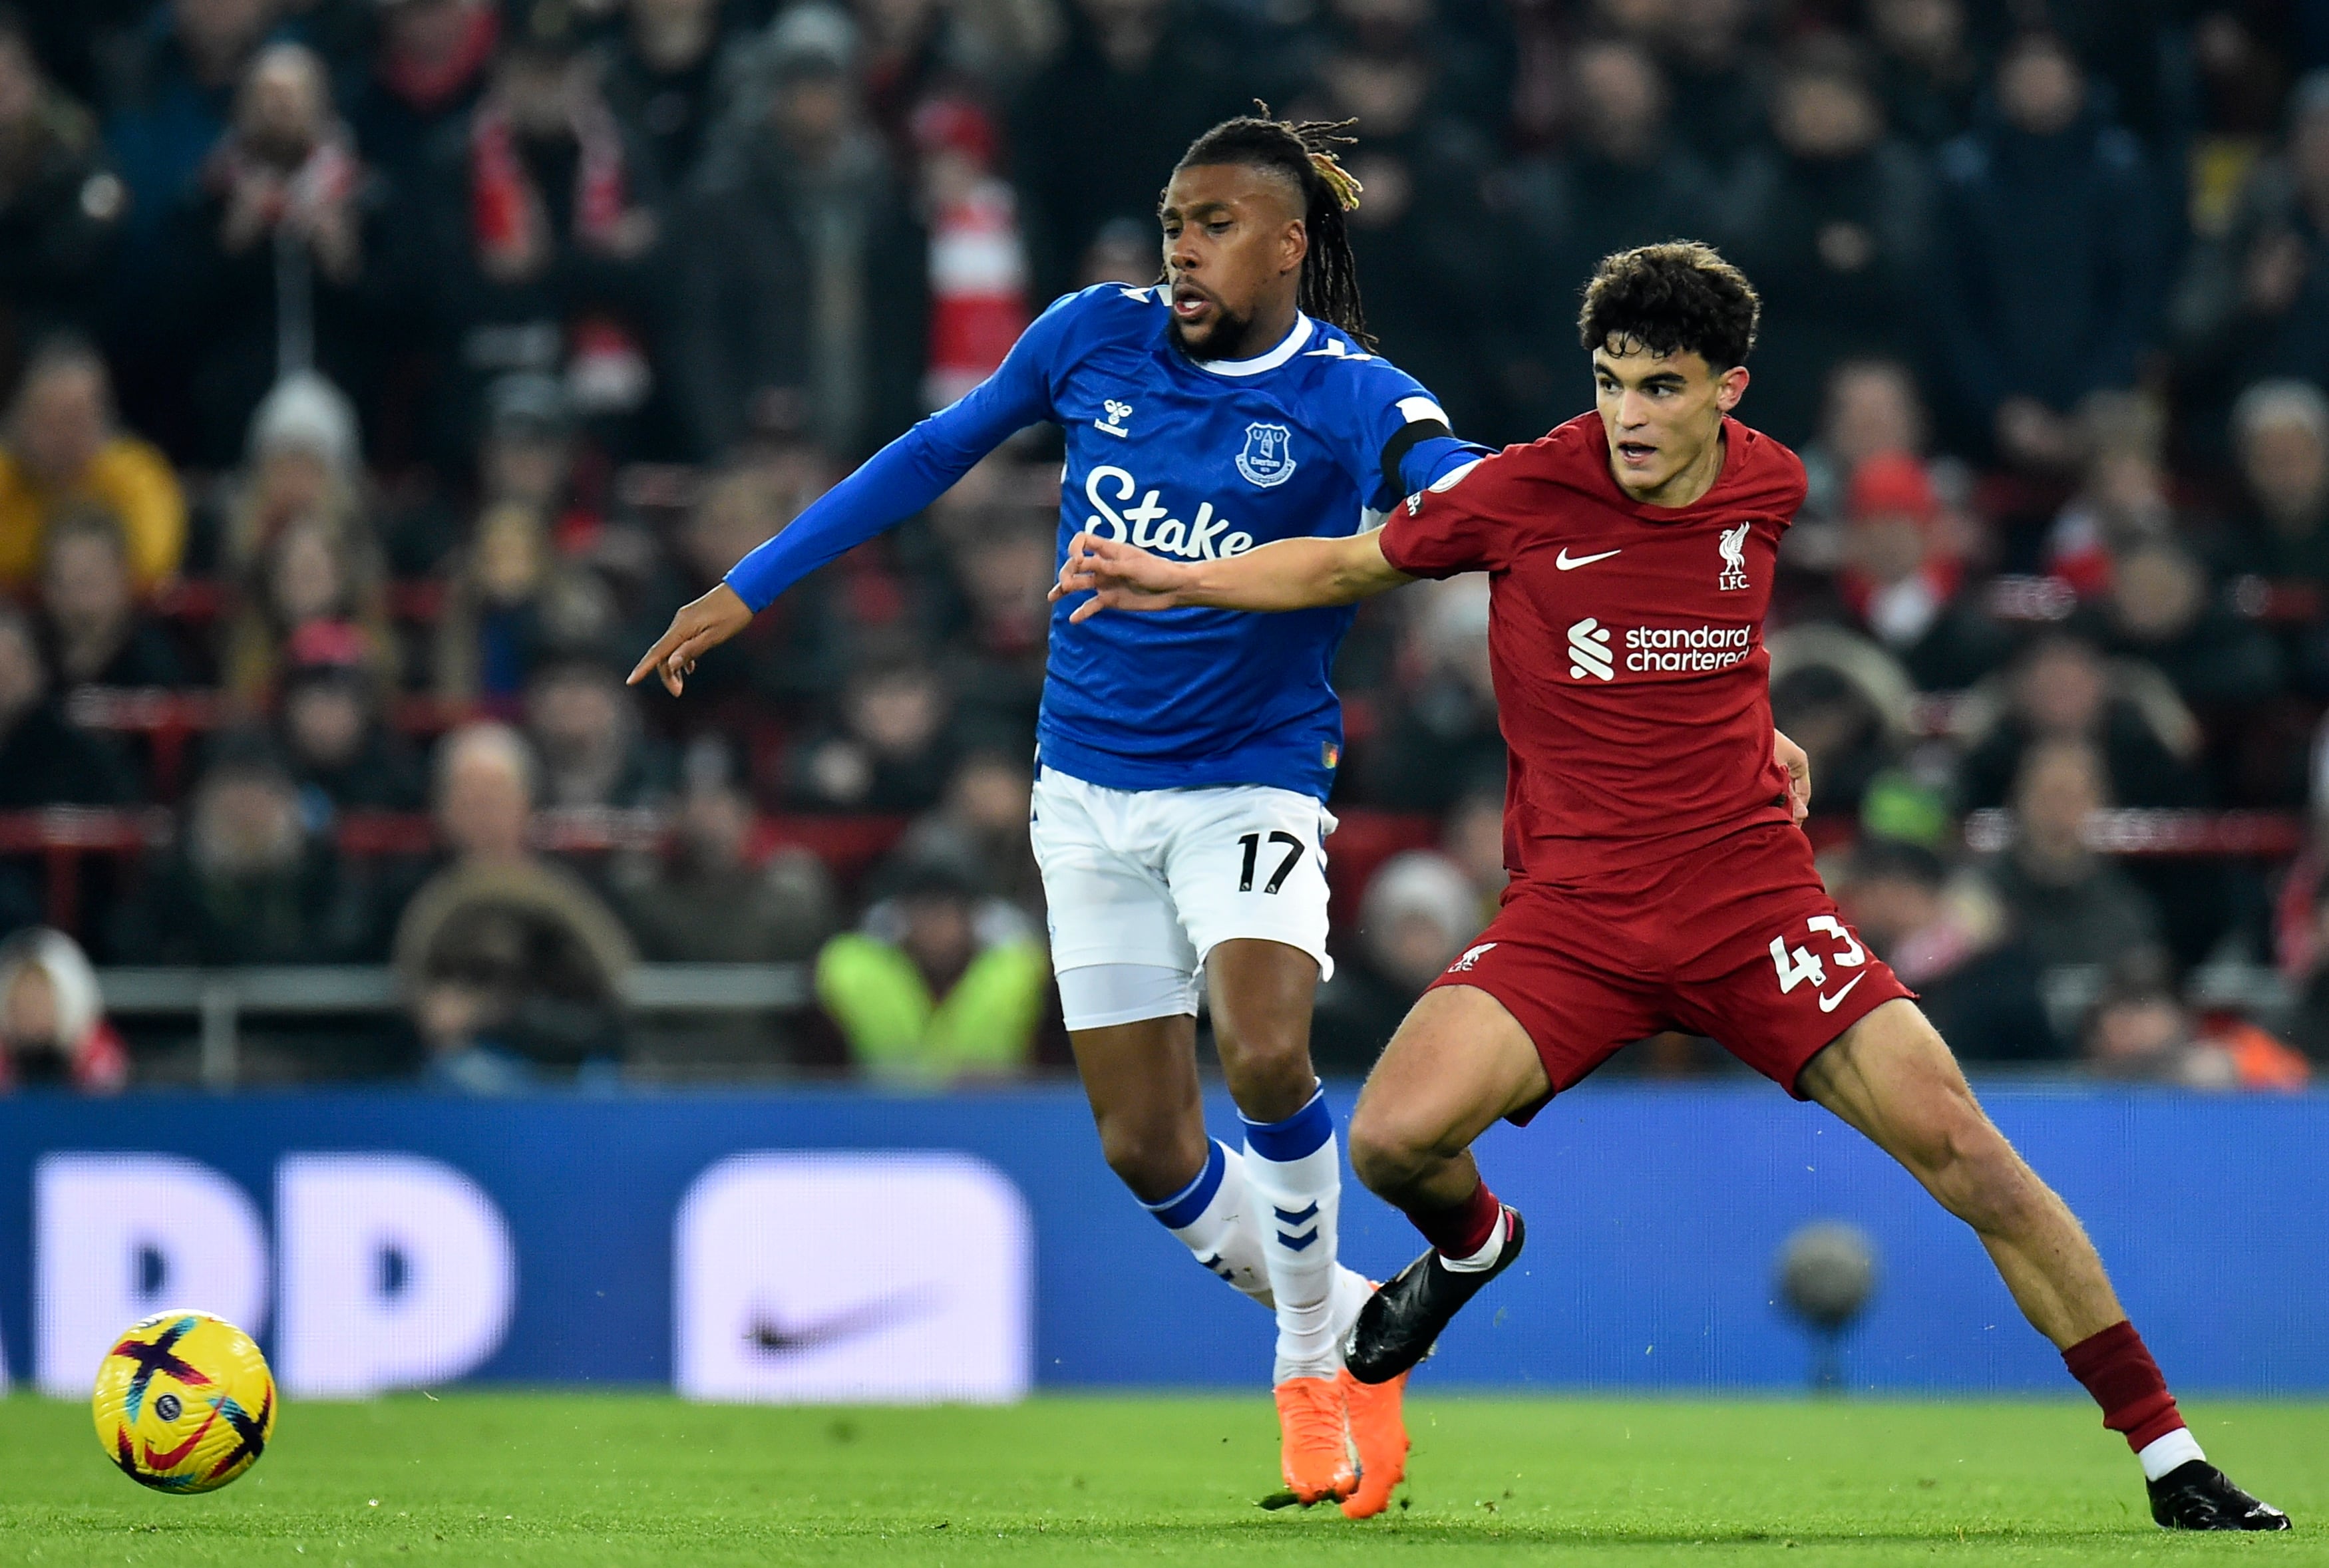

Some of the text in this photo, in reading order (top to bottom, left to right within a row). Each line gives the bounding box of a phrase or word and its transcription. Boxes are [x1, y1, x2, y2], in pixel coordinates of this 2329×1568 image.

[1251, 456, 1280, 468] Everton
[1085, 465, 1253, 561] Stake
[1626, 624, 1751, 649] standard
[1626, 645, 1749, 671] chartered
[1237, 830, 1306, 895] 17
[1769, 915, 1865, 994] 43
